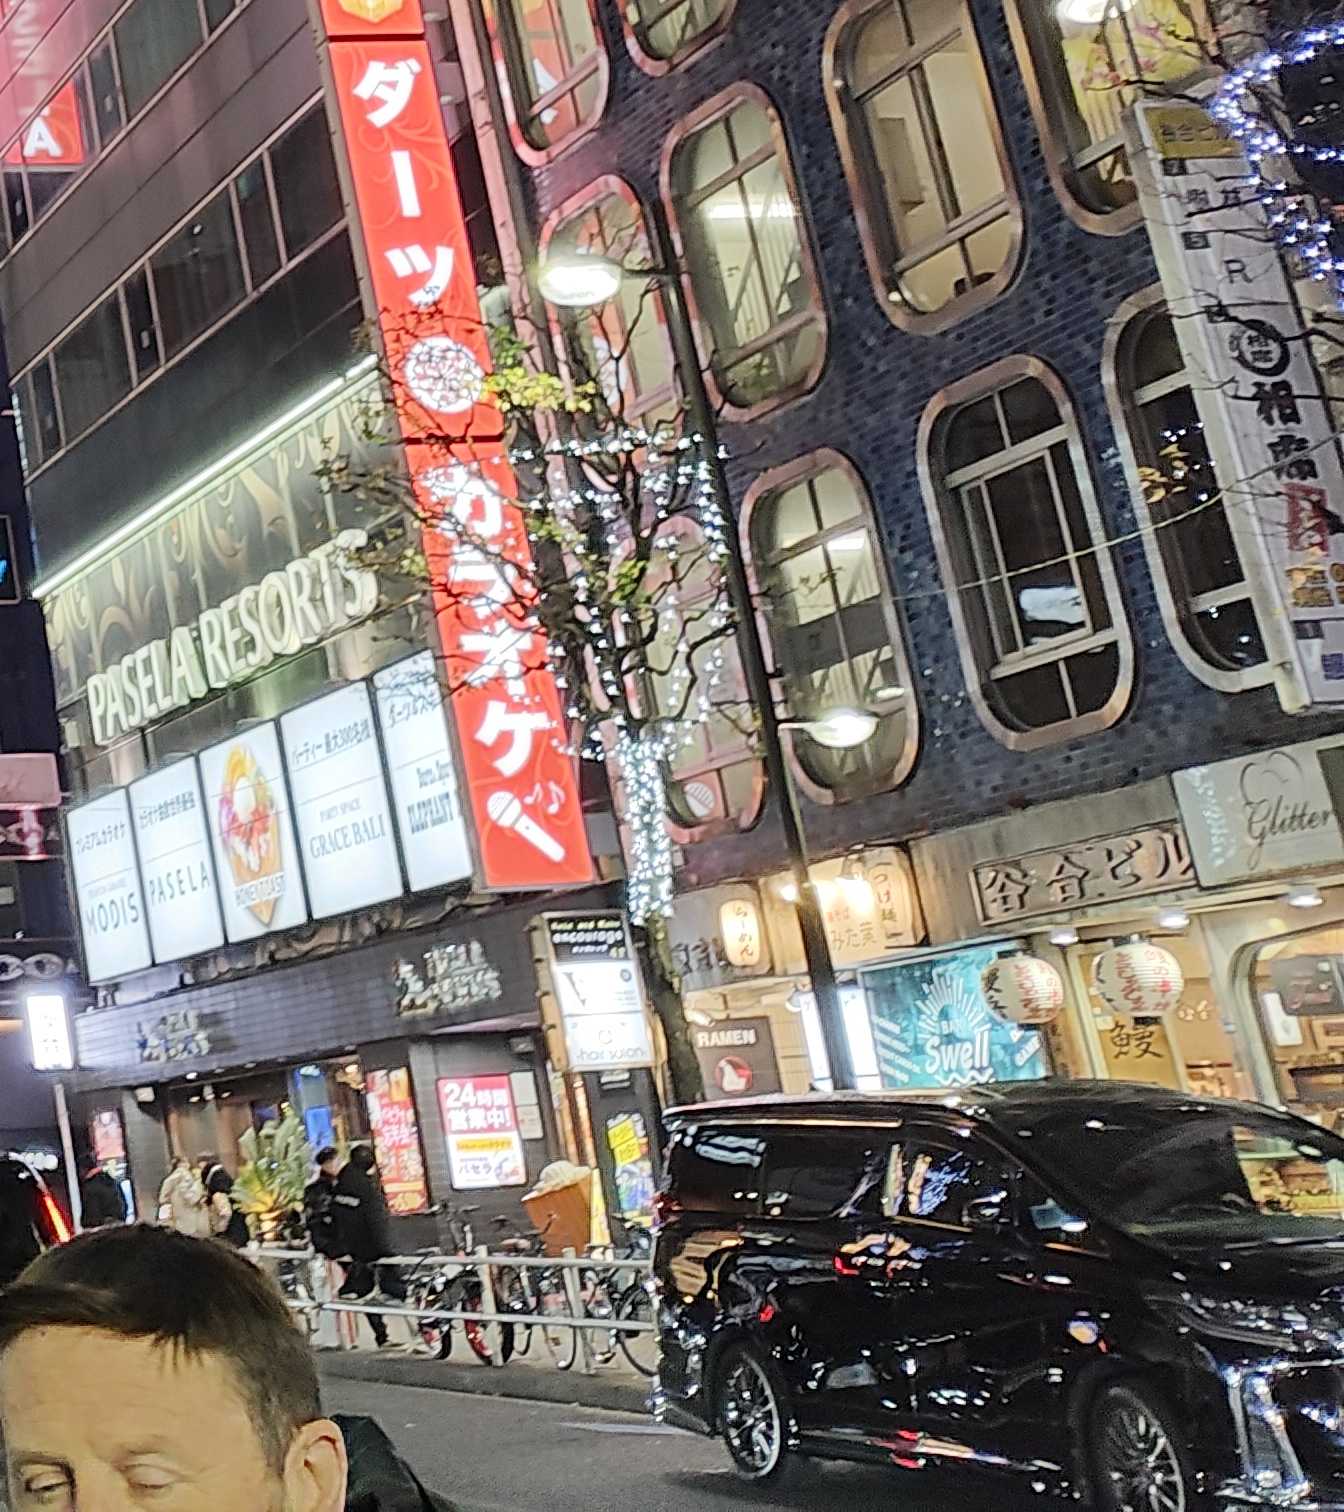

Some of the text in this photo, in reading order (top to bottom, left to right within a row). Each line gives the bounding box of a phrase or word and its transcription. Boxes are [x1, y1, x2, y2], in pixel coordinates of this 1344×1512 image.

[352, 58, 455, 306] ダーツ
[86, 530, 379, 745] PASELA RESORTS
[419, 460, 550, 777] カラオケ
[309, 813, 387, 860] GRACE BALI
[1245, 794, 1333, 872] Glitter
[148, 860, 211, 906] PASELA
[86, 892, 141, 936] MODIS
[733, 903, 756, 960] らーめん
[696, 1028, 756, 1048] RAMEN
[924, 1023, 993, 1075] Swell
[941, 1019, 964, 1036] BAR
[1109, 1024, 1163, 1059] 鰻
[1014, 1035, 1042, 1067] GAME
[444, 1081, 509, 1109] 24時間
[448, 1107, 512, 1132] 営業中!
